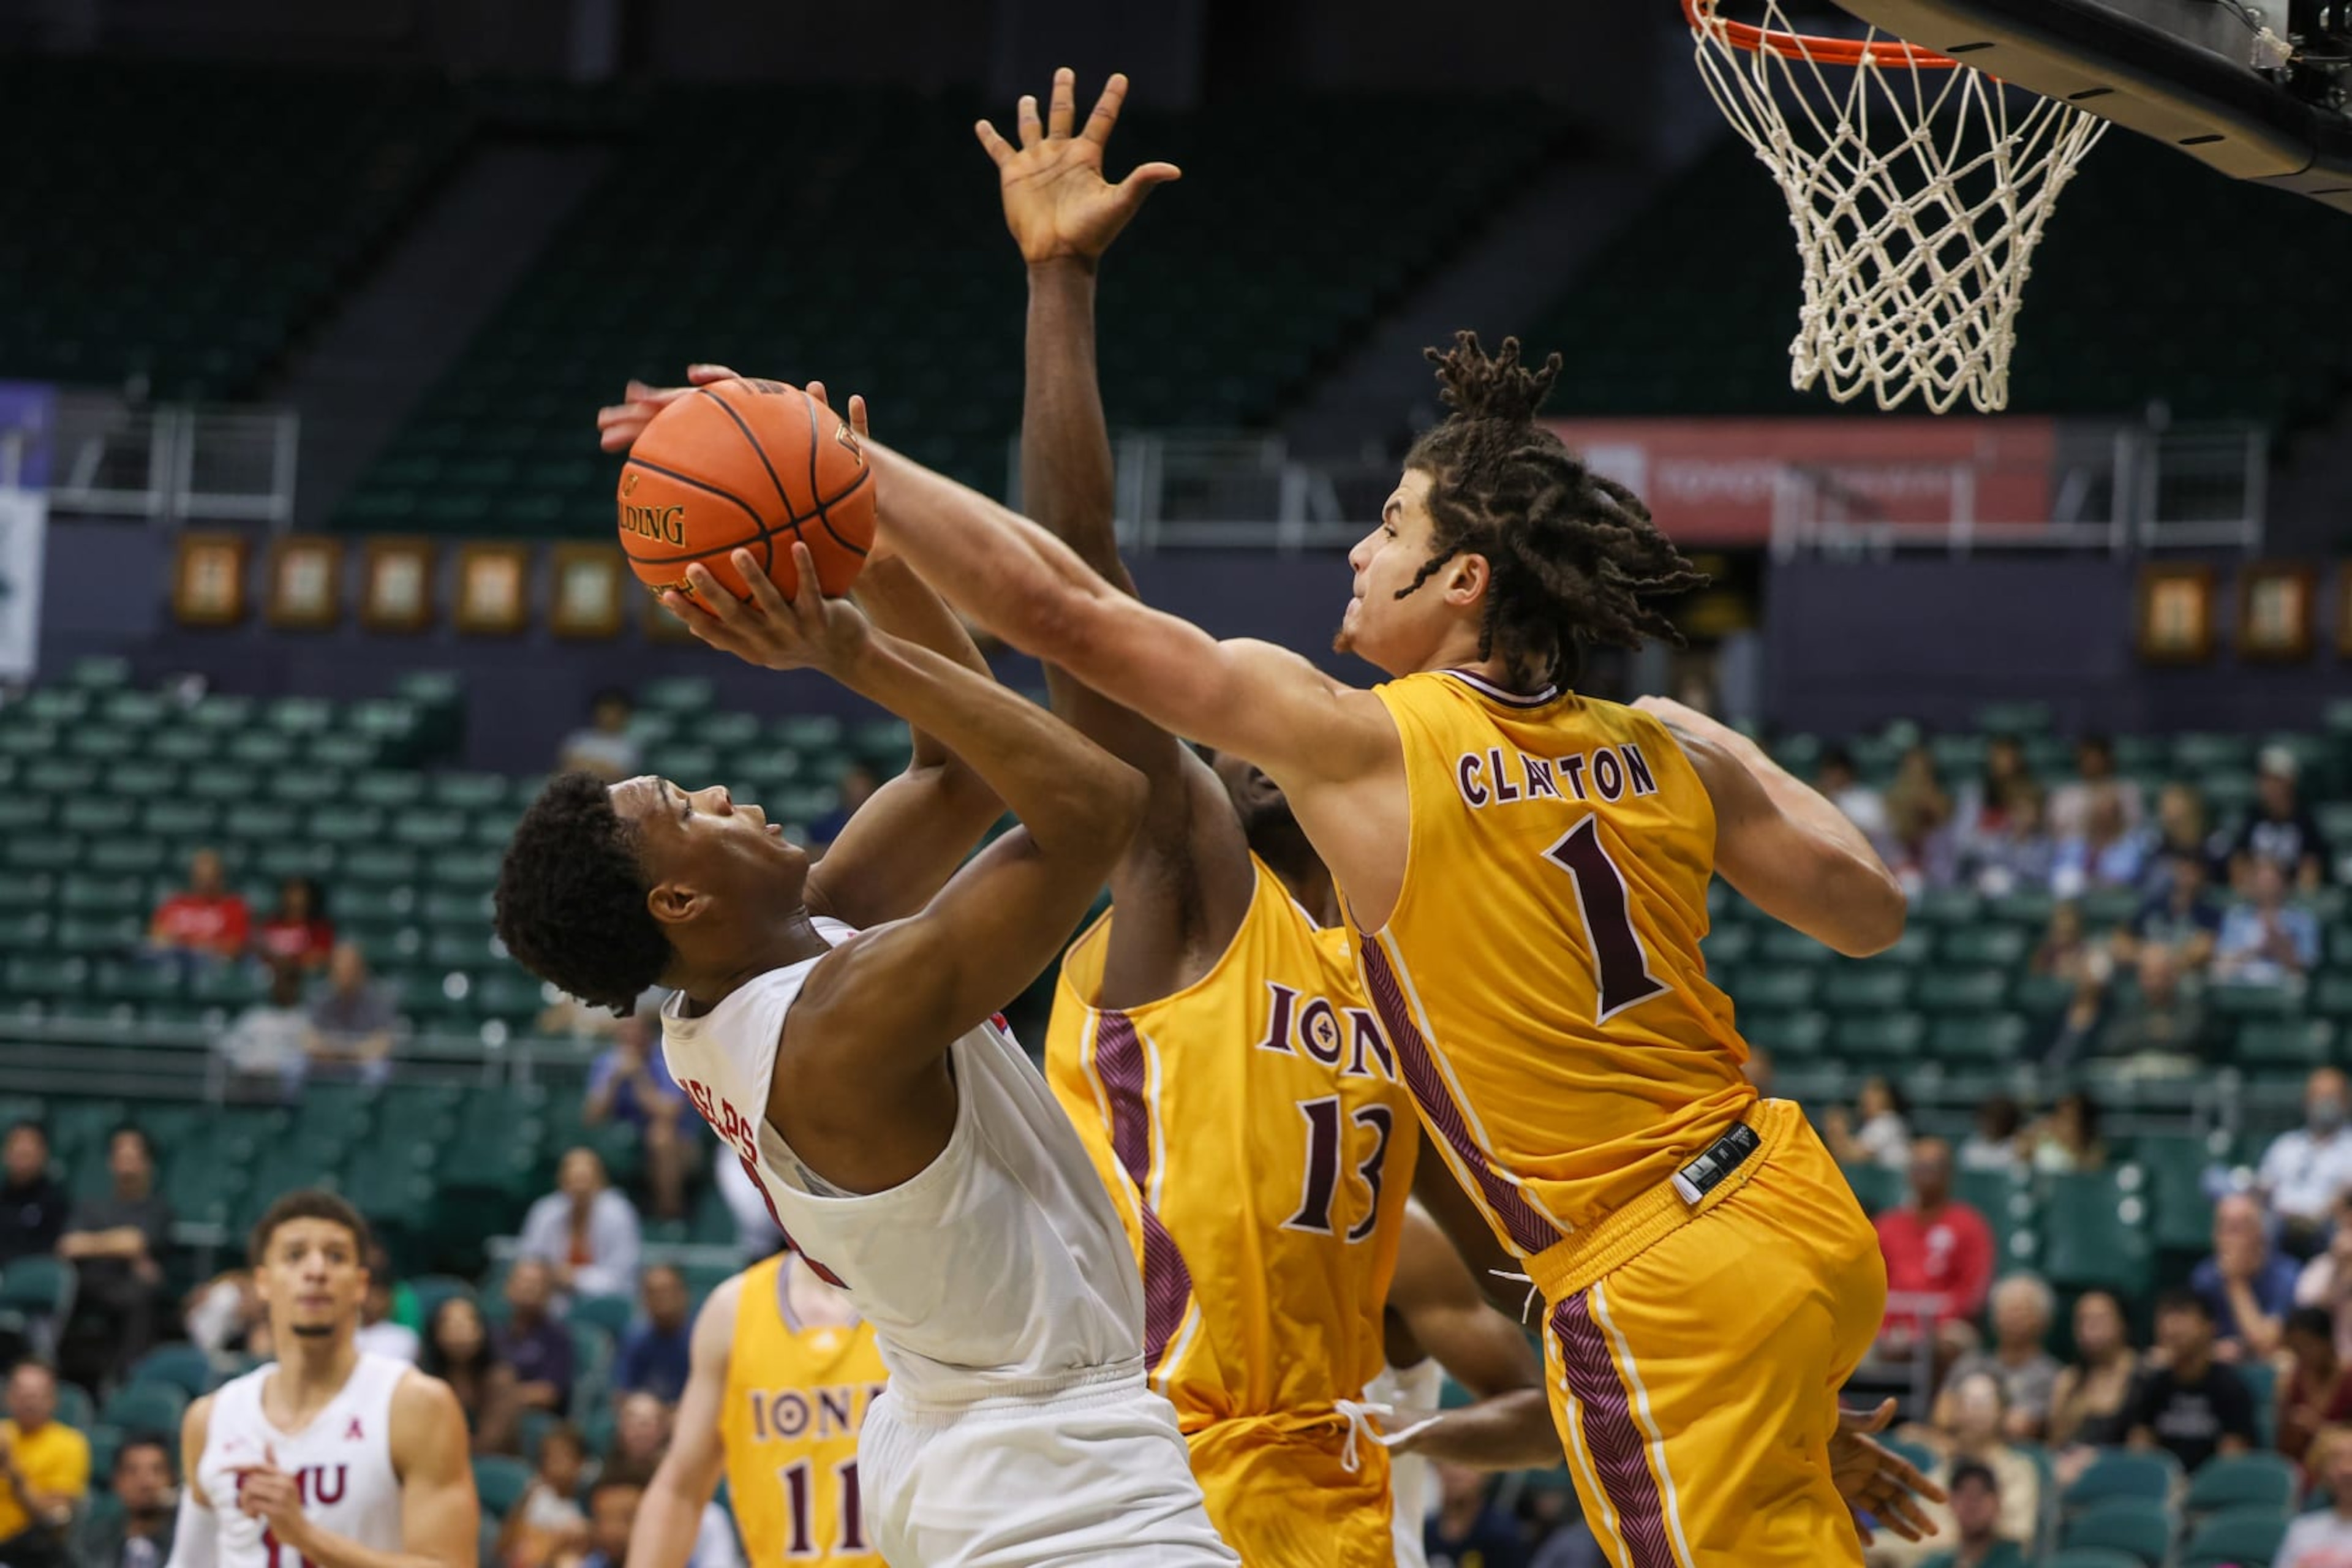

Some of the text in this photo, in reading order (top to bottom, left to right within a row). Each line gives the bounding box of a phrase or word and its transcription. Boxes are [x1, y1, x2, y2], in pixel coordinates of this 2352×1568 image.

[1539, 812, 1675, 1027] 1
[1256, 980, 1405, 1088] ION
[1280, 1095, 1393, 1244] 13
[775, 1455, 875, 1561] 11
